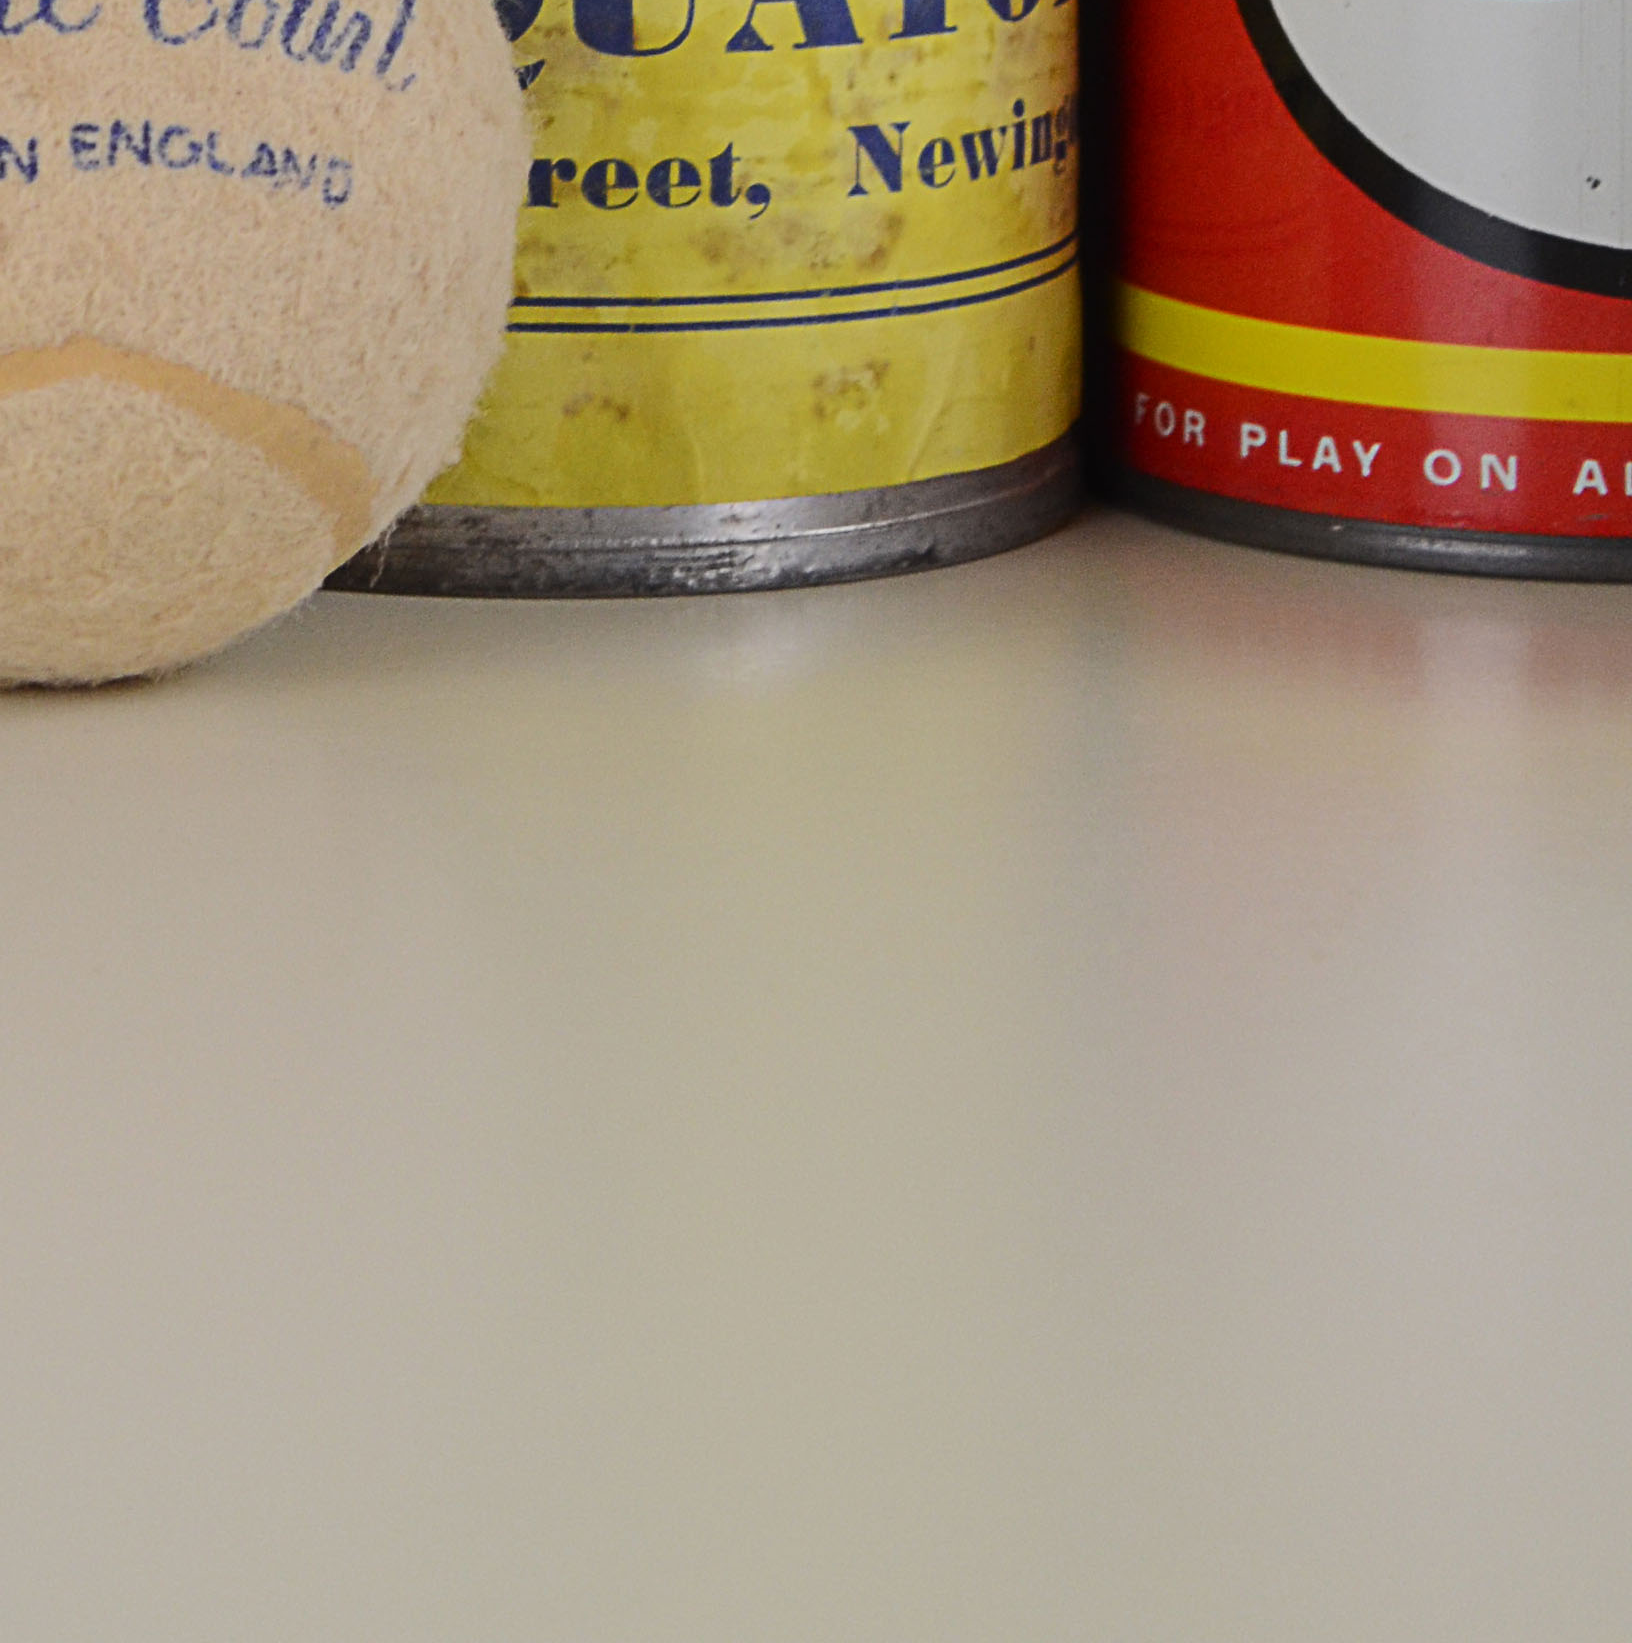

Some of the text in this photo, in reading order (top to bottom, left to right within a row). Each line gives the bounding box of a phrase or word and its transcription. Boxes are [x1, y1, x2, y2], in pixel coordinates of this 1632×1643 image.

[72, 121, 357, 208] ENGLAND
[1136, 392, 1206, 446] FOR
[1240, 422, 1381, 478] PLAY
[1423, 449, 1518, 491] ON
